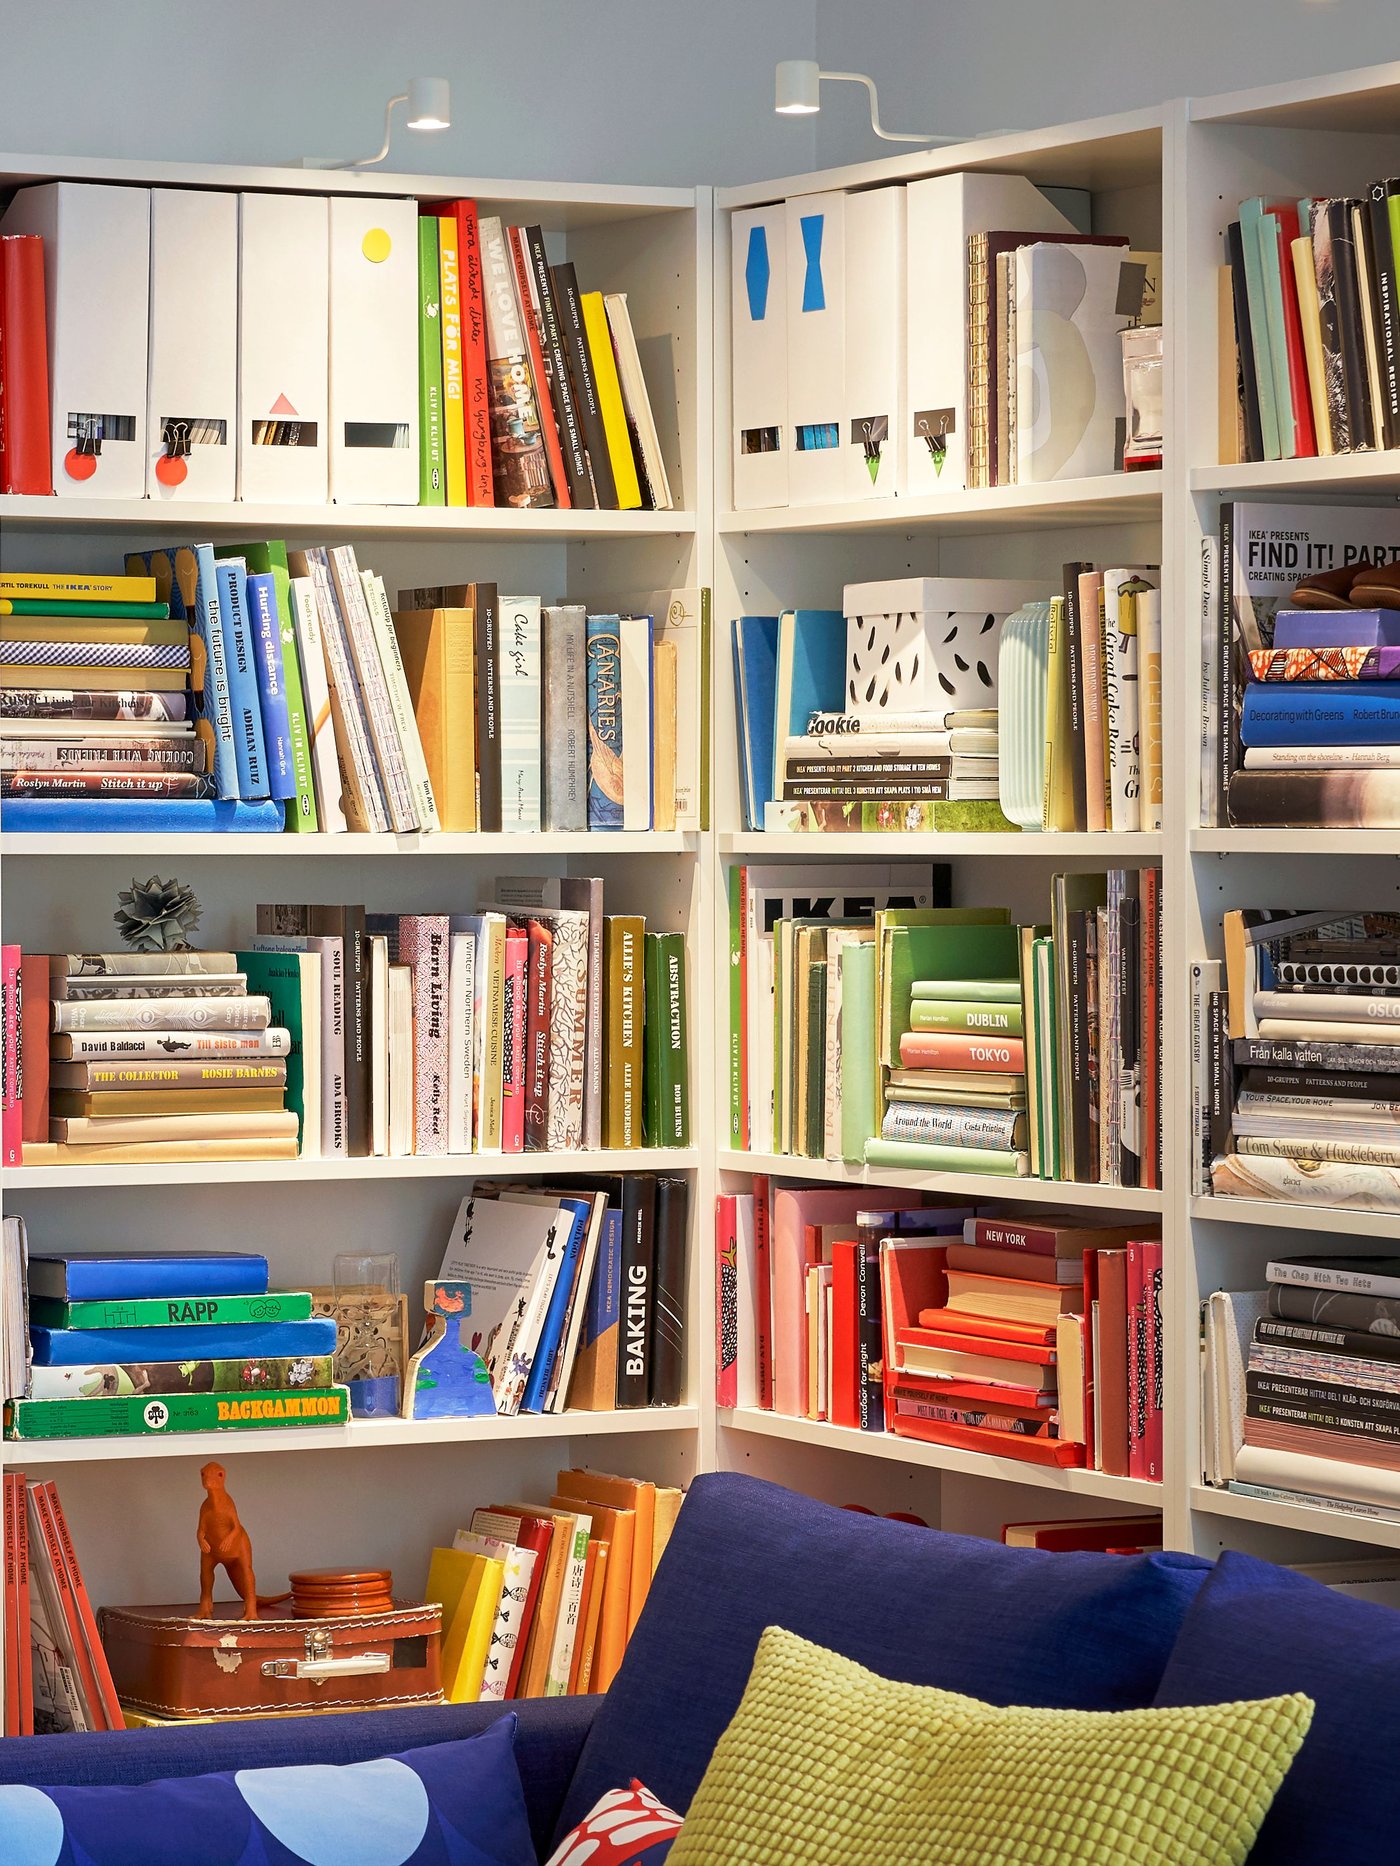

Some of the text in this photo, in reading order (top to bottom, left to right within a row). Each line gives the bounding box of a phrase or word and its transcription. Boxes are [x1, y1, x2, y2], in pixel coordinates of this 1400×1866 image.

[534, 243, 542, 259] IKEA
[538, 261, 548, 296] PRESENTS
[544, 297, 552, 314] FIND
[443, 250, 460, 400] PLATS FÖR MIG!
[489, 238, 533, 421] WE LOVE HOME
[549, 324, 558, 342] PART
[567, 288, 596, 416] 10-GRUPPEN PATTERNS AND PEOPLE
[1380, 272, 1398, 415] INSPIRATIONAL RECIPES
[554, 349, 566, 384] CREATING
[560, 384, 568, 404] SPACE
[564, 404, 570, 412] IN
[570, 429, 580, 452] SMALL
[574, 452, 584, 476] HOMES
[1248, 530, 1310, 541] IKEA PRESENTS
[1248, 542, 1298, 568] FIND
[1307, 544, 1334, 569] IT!
[16, 582, 49, 590] TOREKULL
[1248, 571, 1285, 581] CREATING
[259, 586, 278, 696] Hurting distance
[509, 614, 528, 676] Cake girl
[566, 634, 574, 645] MY
[208, 600, 232, 741] the future is bright
[228, 572, 260, 785] PRODUCT DESIGN ADRIAN RUIZ
[587, 634, 621, 742] CANARIES
[1250, 709, 1380, 724] Decorating with Greens Robert
[60, 749, 193, 764] COOKING WITH FRIENDS
[16, 777, 163, 790] Roslyn Martin Stitch it up
[568, 761, 576, 802] HUMPHREY
[463, 941, 473, 1079] Winter in Northern Sweden
[490, 970, 499, 1066] VIETNAMESE CUISINE
[535, 943, 547, 1096] Roslyn Martin Stitch it up
[966, 1013, 1008, 1028] DUBLIN
[82, 1039, 259, 1051] David Baldacci Till siste man
[429, 934, 442, 1134] Barn Living Kelly Reed
[568, 962, 586, 1109] SUMMER
[623, 931, 633, 1146] ALLIE'S KITCHEN ALLIE HENDERSON
[669, 955, 683, 1137] ABSTRACTION ROB BURNS
[1213, 1034, 1219, 1043] IN
[333, 950, 342, 1148] SOUL READING ADA BROOKS
[969, 1048, 1009, 1062] TOKYO
[1250, 1045, 1322, 1062] Från kalla vatten
[94, 1067, 278, 1082] THE COLLECTOR ROSIE BARNES
[920, 1117, 930, 1127] the
[931, 1118, 952, 1130] World
[981, 1123, 1005, 1134] Printing
[1244, 1137, 1270, 1153] Tom
[1273, 1140, 1308, 1157] Sawer
[1310, 1142, 1321, 1158] &
[570, 1219, 584, 1259] POLYGON
[986, 1230, 1026, 1246] NEW YORK
[606, 1248, 614, 1294] DEMOCRATIC
[1274, 1267, 1287, 1278] The
[1314, 1272, 1331, 1283] With
[168, 1302, 218, 1323] RAPP
[626, 1266, 647, 1376] BAKING
[860, 1371, 868, 1428] Outdoor for
[1257, 1381, 1309, 1397] IKEA PRESENTERAR
[217, 1397, 340, 1421] BACKGAMMON
[51, 1493, 82, 1588] MAKE YOURSELF AT HOME
